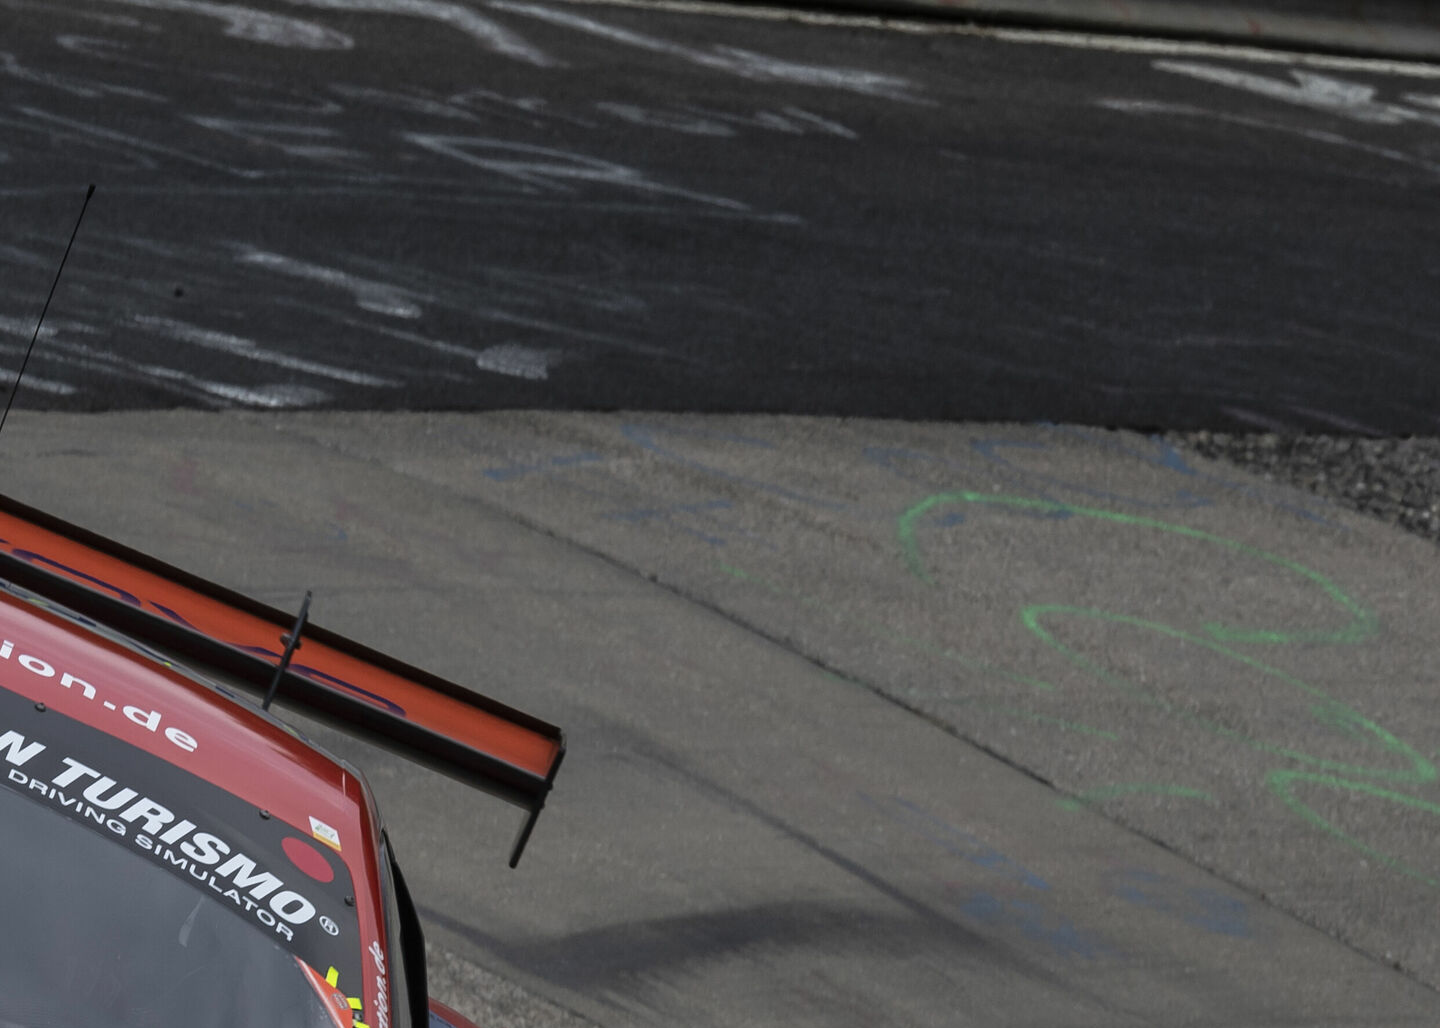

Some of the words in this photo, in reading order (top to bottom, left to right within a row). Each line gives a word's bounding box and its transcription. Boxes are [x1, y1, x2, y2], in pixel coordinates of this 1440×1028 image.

[9, 769, 127, 836] DRIVING
[135, 833, 297, 942] SIMULATOR
[52, 757, 316, 925] TURISMO
